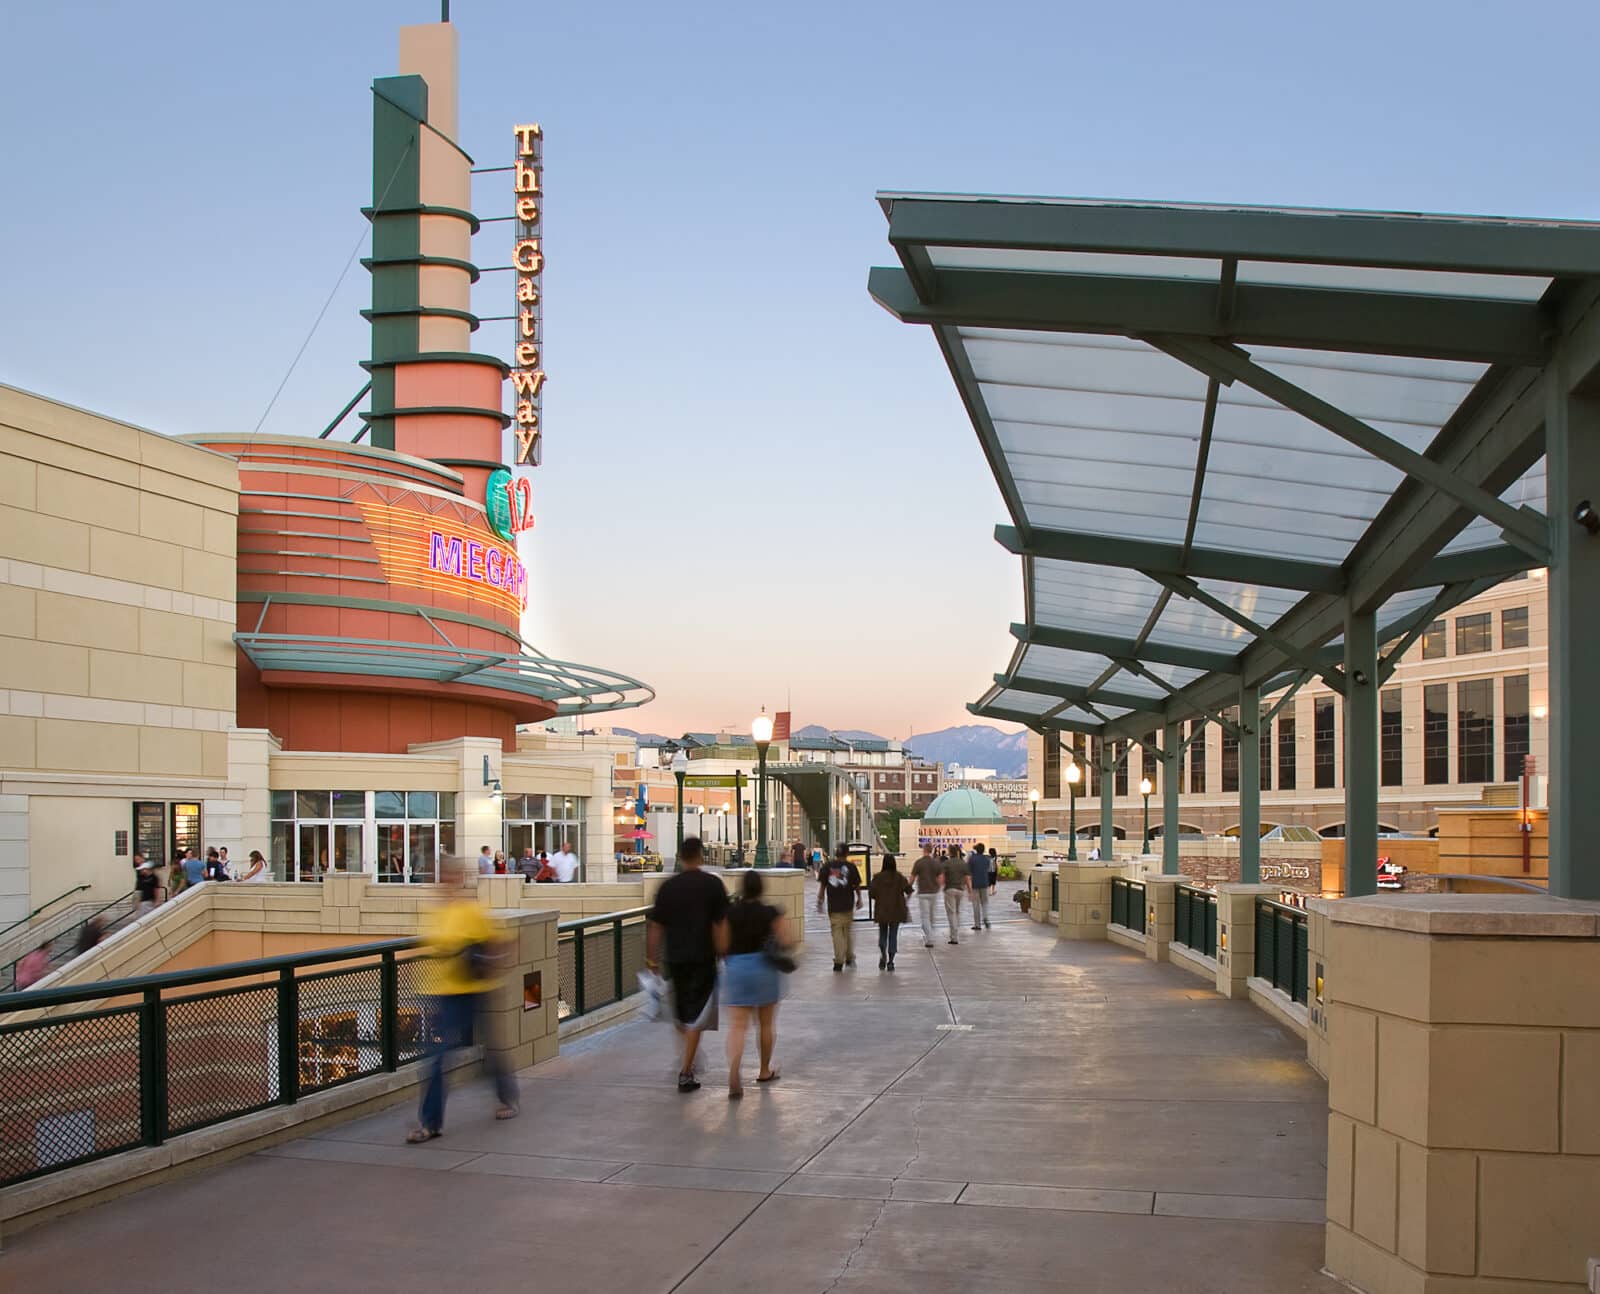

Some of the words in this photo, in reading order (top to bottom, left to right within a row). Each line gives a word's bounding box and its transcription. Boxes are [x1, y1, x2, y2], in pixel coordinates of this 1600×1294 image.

[513, 123, 543, 221] The
[510, 239, 546, 466] Gateway
[505, 476, 536, 534] 12
[428, 529, 528, 612] MEGAP
